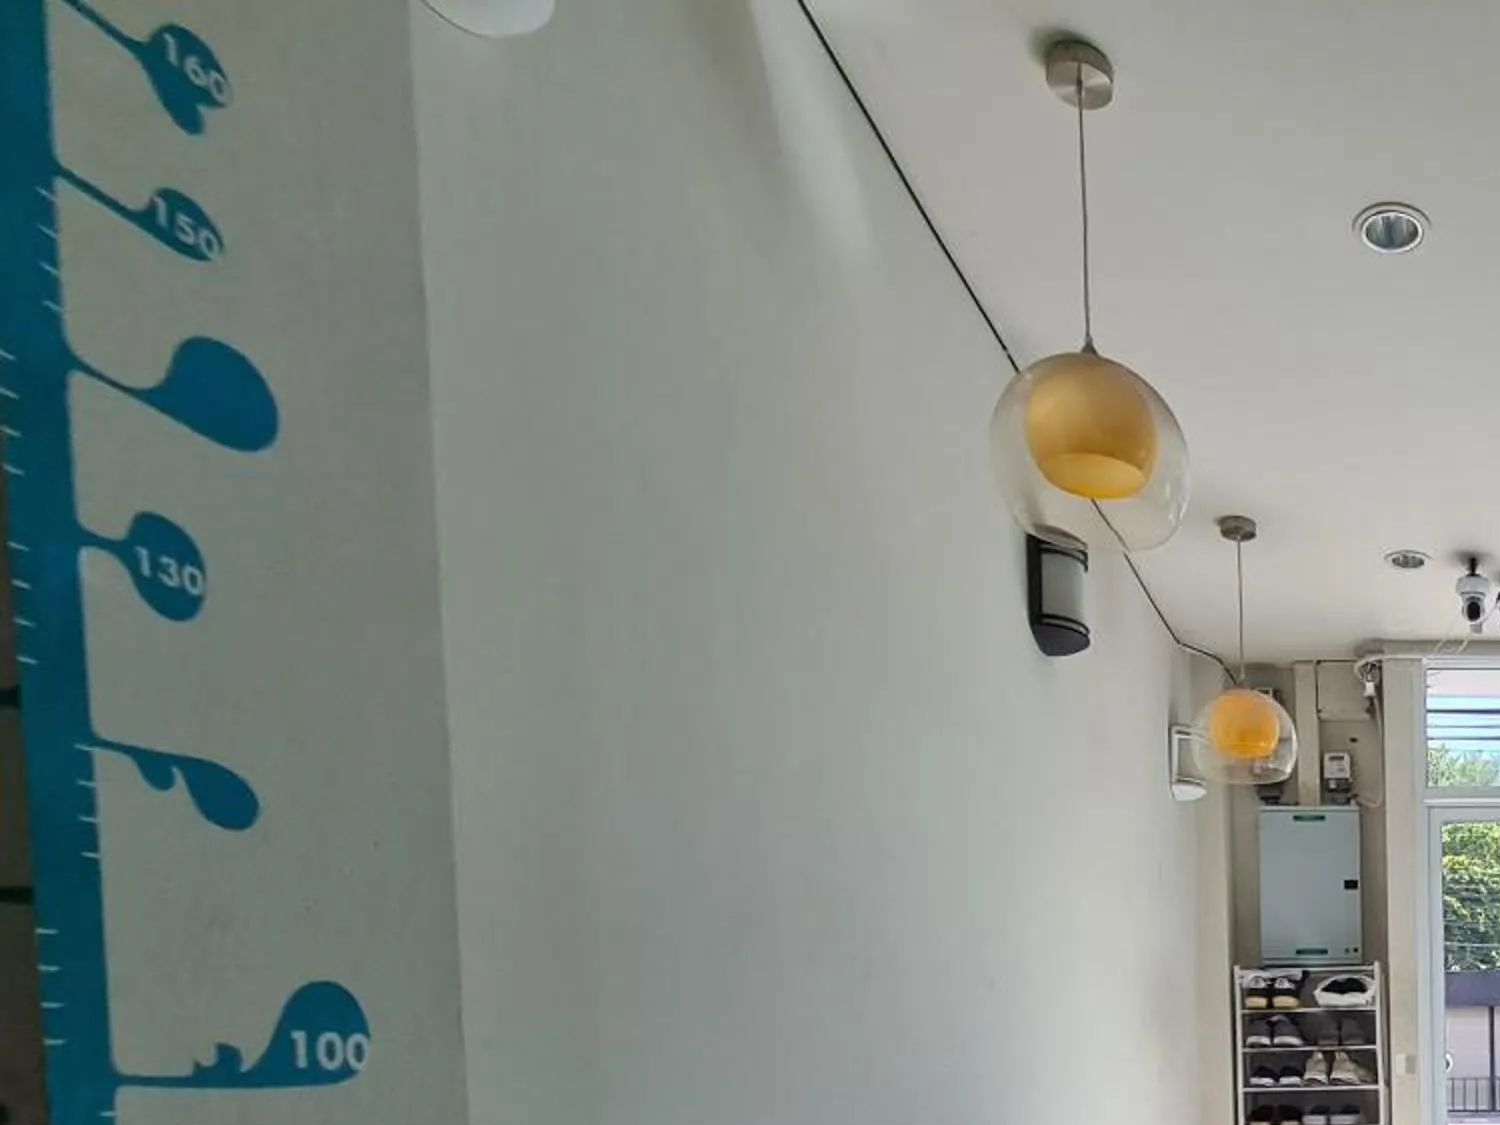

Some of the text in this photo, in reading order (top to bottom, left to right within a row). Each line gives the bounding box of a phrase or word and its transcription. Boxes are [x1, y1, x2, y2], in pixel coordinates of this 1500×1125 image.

[162, 33, 229, 100] 160
[152, 196, 221, 259] 150
[134, 546, 203, 596] 130
[290, 1031, 369, 1071] 100
